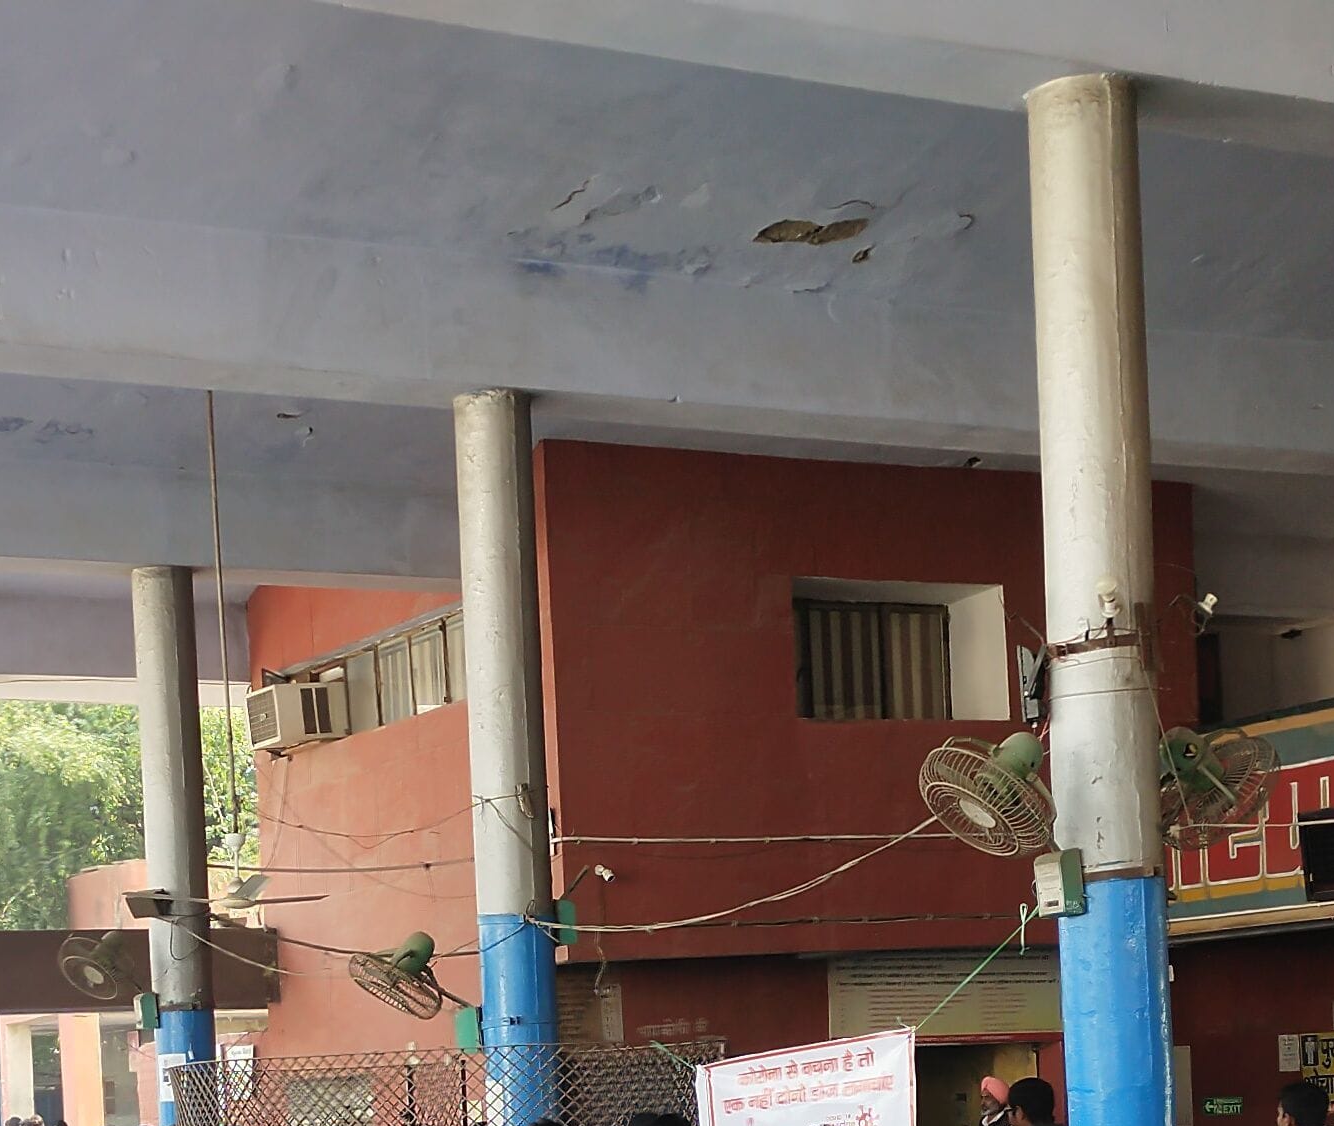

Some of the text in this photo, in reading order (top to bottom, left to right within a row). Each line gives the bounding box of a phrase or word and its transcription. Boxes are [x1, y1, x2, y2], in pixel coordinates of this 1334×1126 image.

[842, 1049, 855, 1071] है
[857, 1046, 875, 1068] तो
[1223, 1104, 1241, 1114] EXIT
